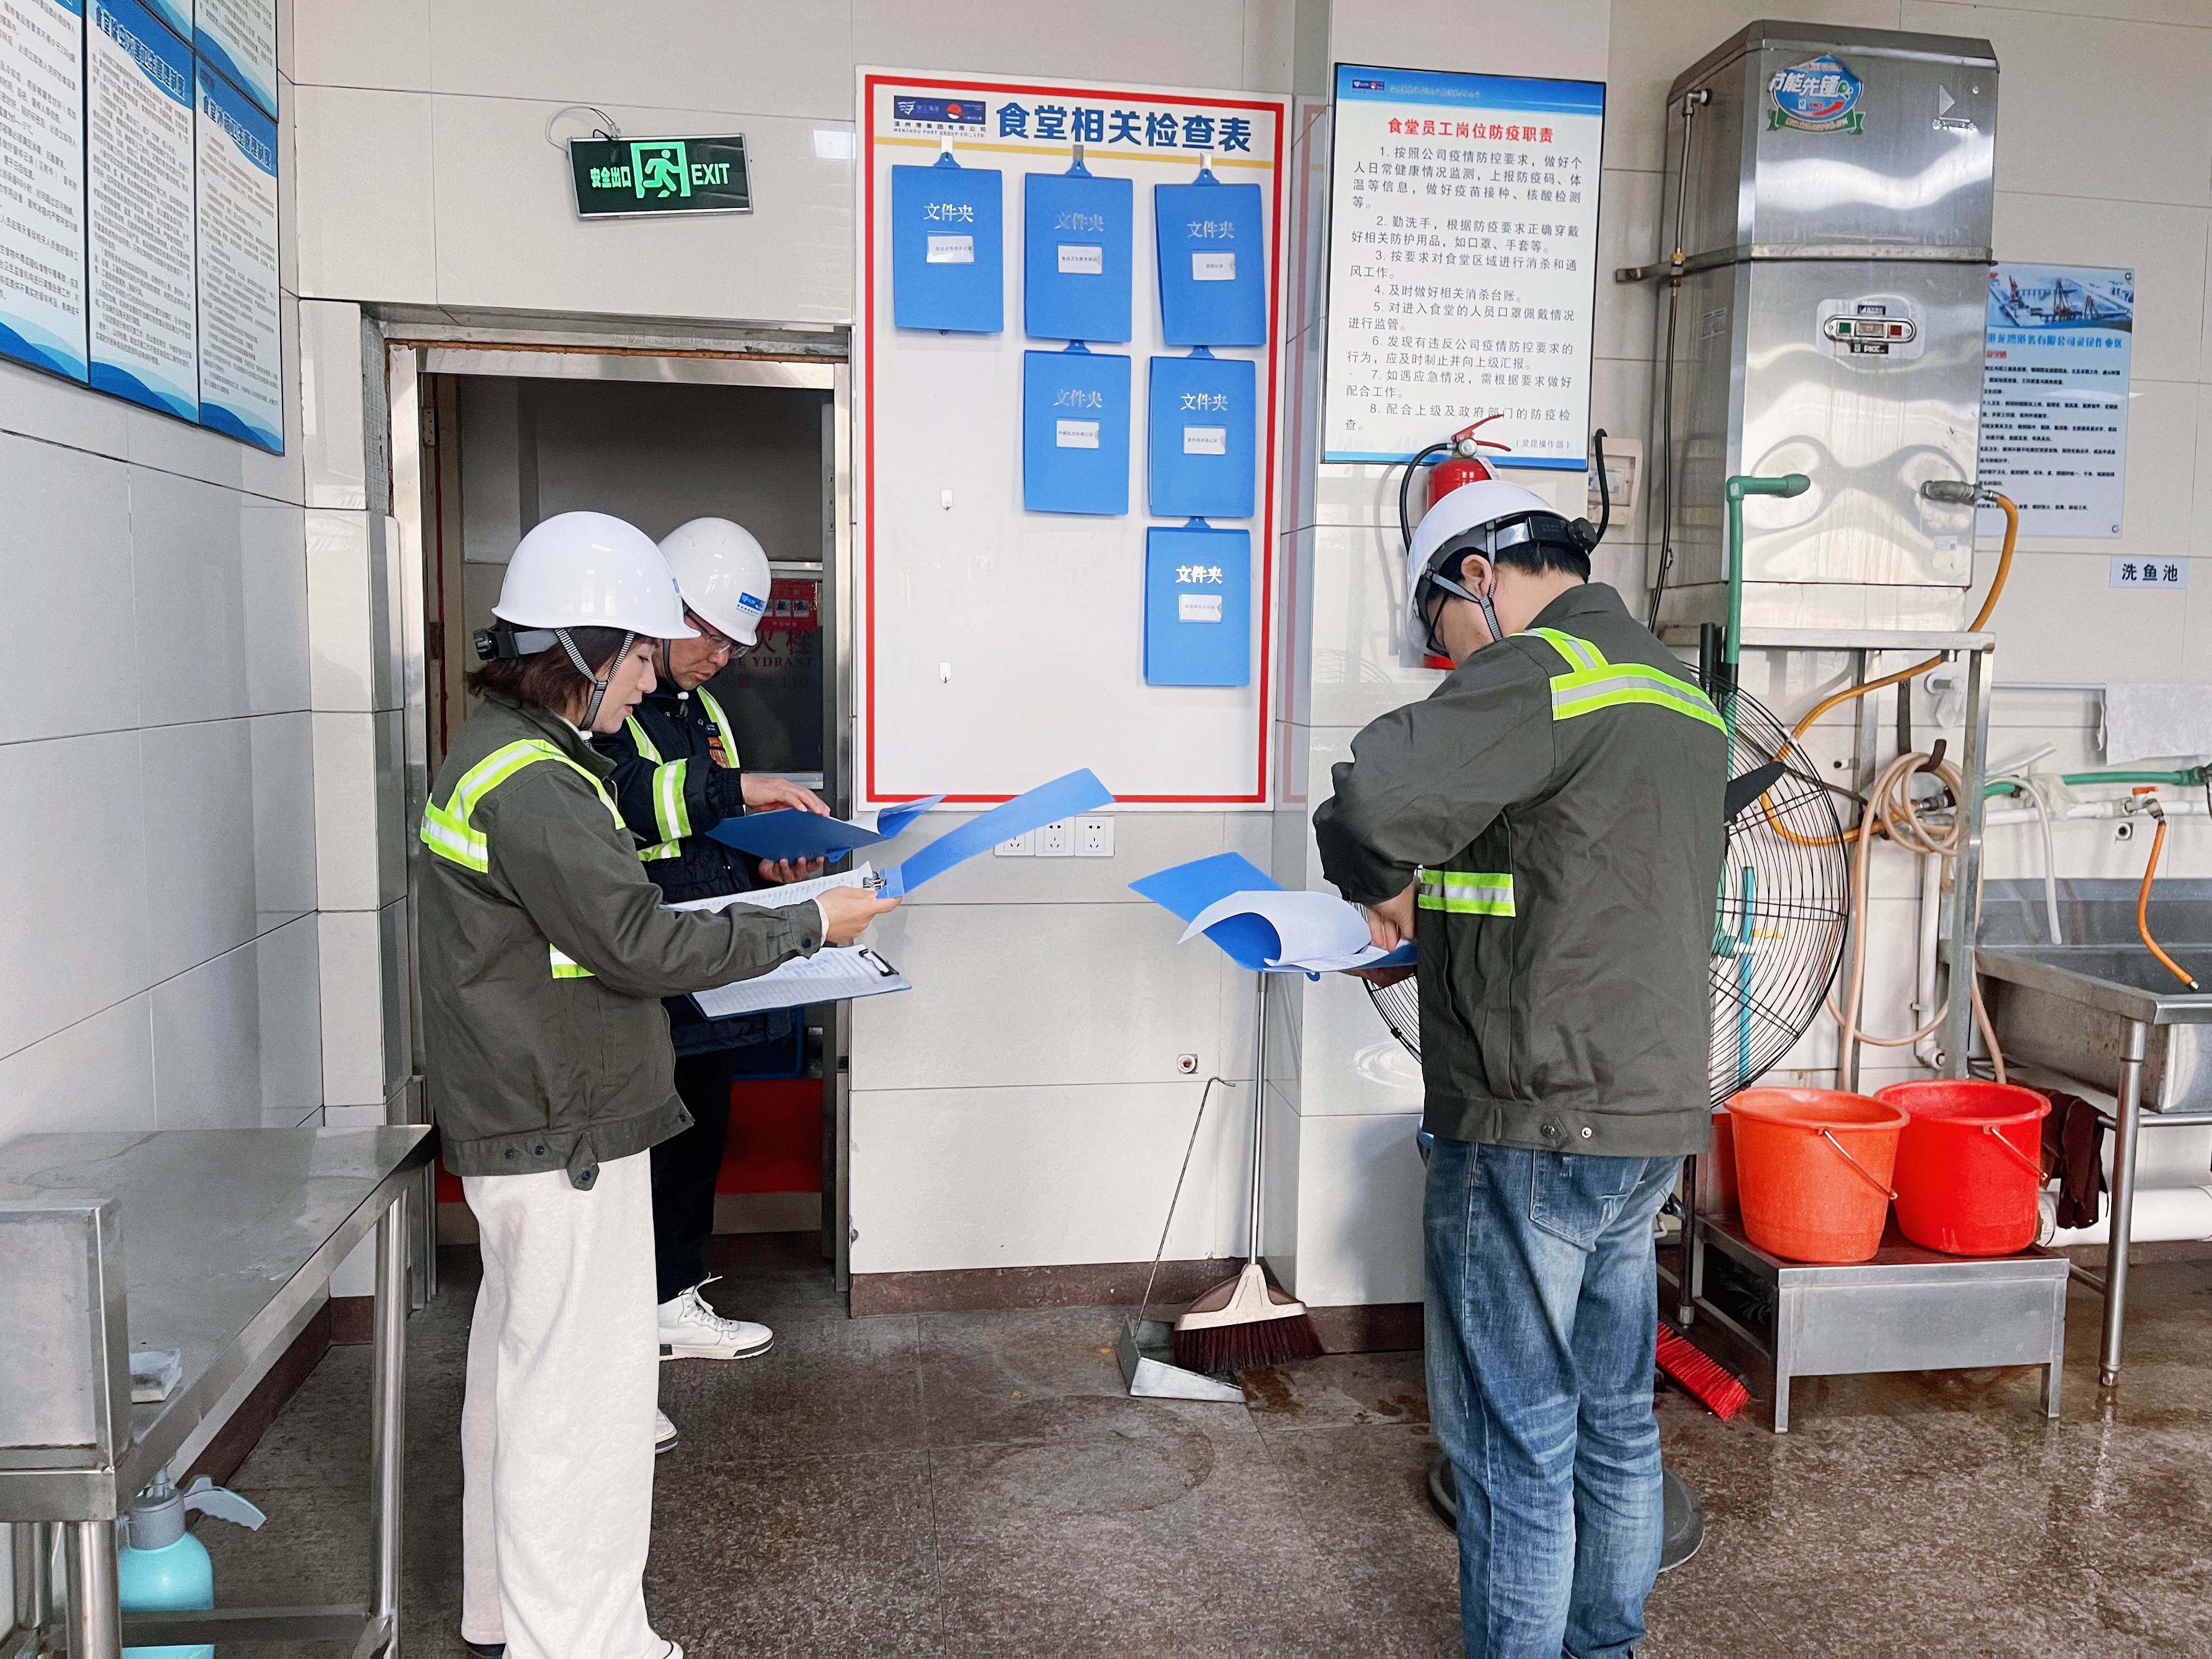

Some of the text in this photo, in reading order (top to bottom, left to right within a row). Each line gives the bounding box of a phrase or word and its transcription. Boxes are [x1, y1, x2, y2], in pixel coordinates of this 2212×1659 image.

[996, 103, 1251, 153] 食堂相关检查表
[1388, 117, 1553, 144] 食堂员工岗位防疫职责
[590, 166, 631, 188] 安全出口
[691, 163, 730, 185] EXIT
[923, 203, 974, 222] 文件夹
[1054, 212, 1104, 232] 文件夹
[1187, 221, 1234, 239] 文件夹
[1053, 389, 1102, 408] 文件夹
[1180, 393, 1228, 411] 文件夹
[1175, 565, 1223, 584] 文件夹
[2122, 563, 2179, 583] 洗鱼池
